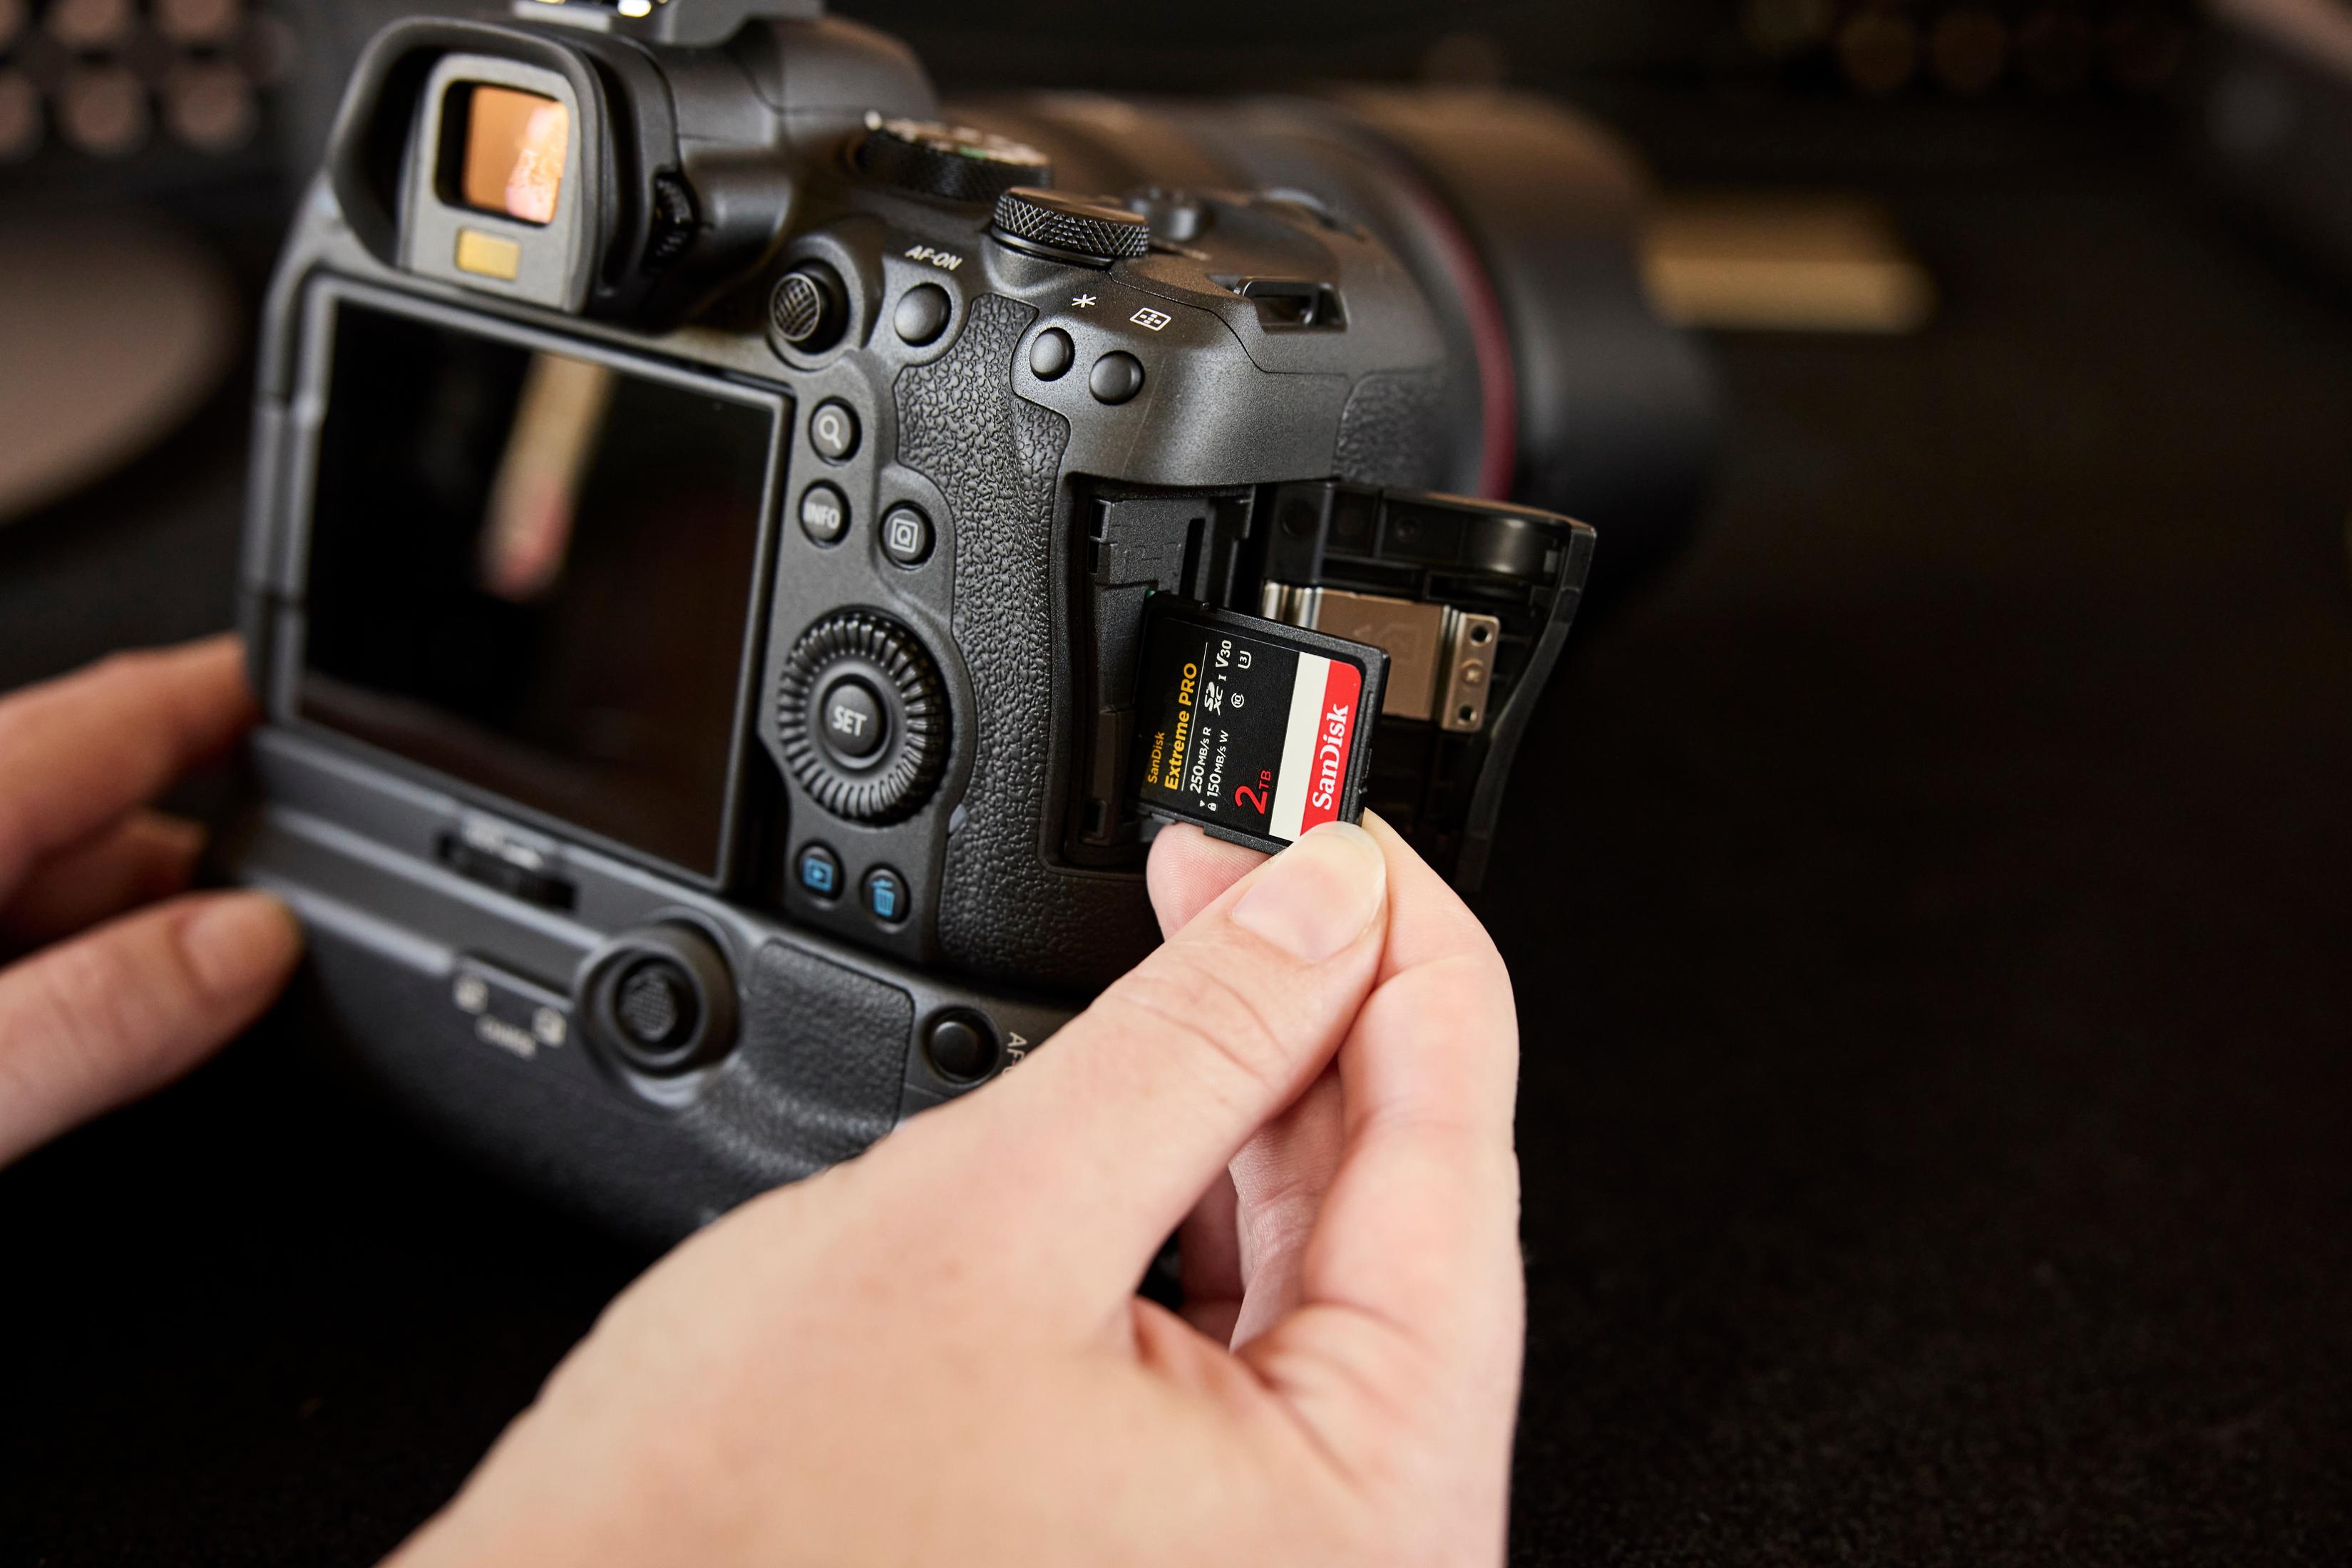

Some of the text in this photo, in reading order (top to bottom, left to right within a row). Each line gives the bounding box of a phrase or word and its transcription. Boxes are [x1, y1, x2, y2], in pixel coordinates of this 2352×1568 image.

[905, 245, 962, 271] AF-ON
[803, 502, 841, 530] INFO
[1215, 640, 1232, 668] V30
[833, 705, 868, 737] SET
[1165, 663, 1197, 790] Extreme PRO
[1203, 727, 1211, 736] R
[1219, 730, 1229, 743] W
[1148, 731, 1165, 784] SanDisk
[1313, 703, 1349, 810] SanDisk
